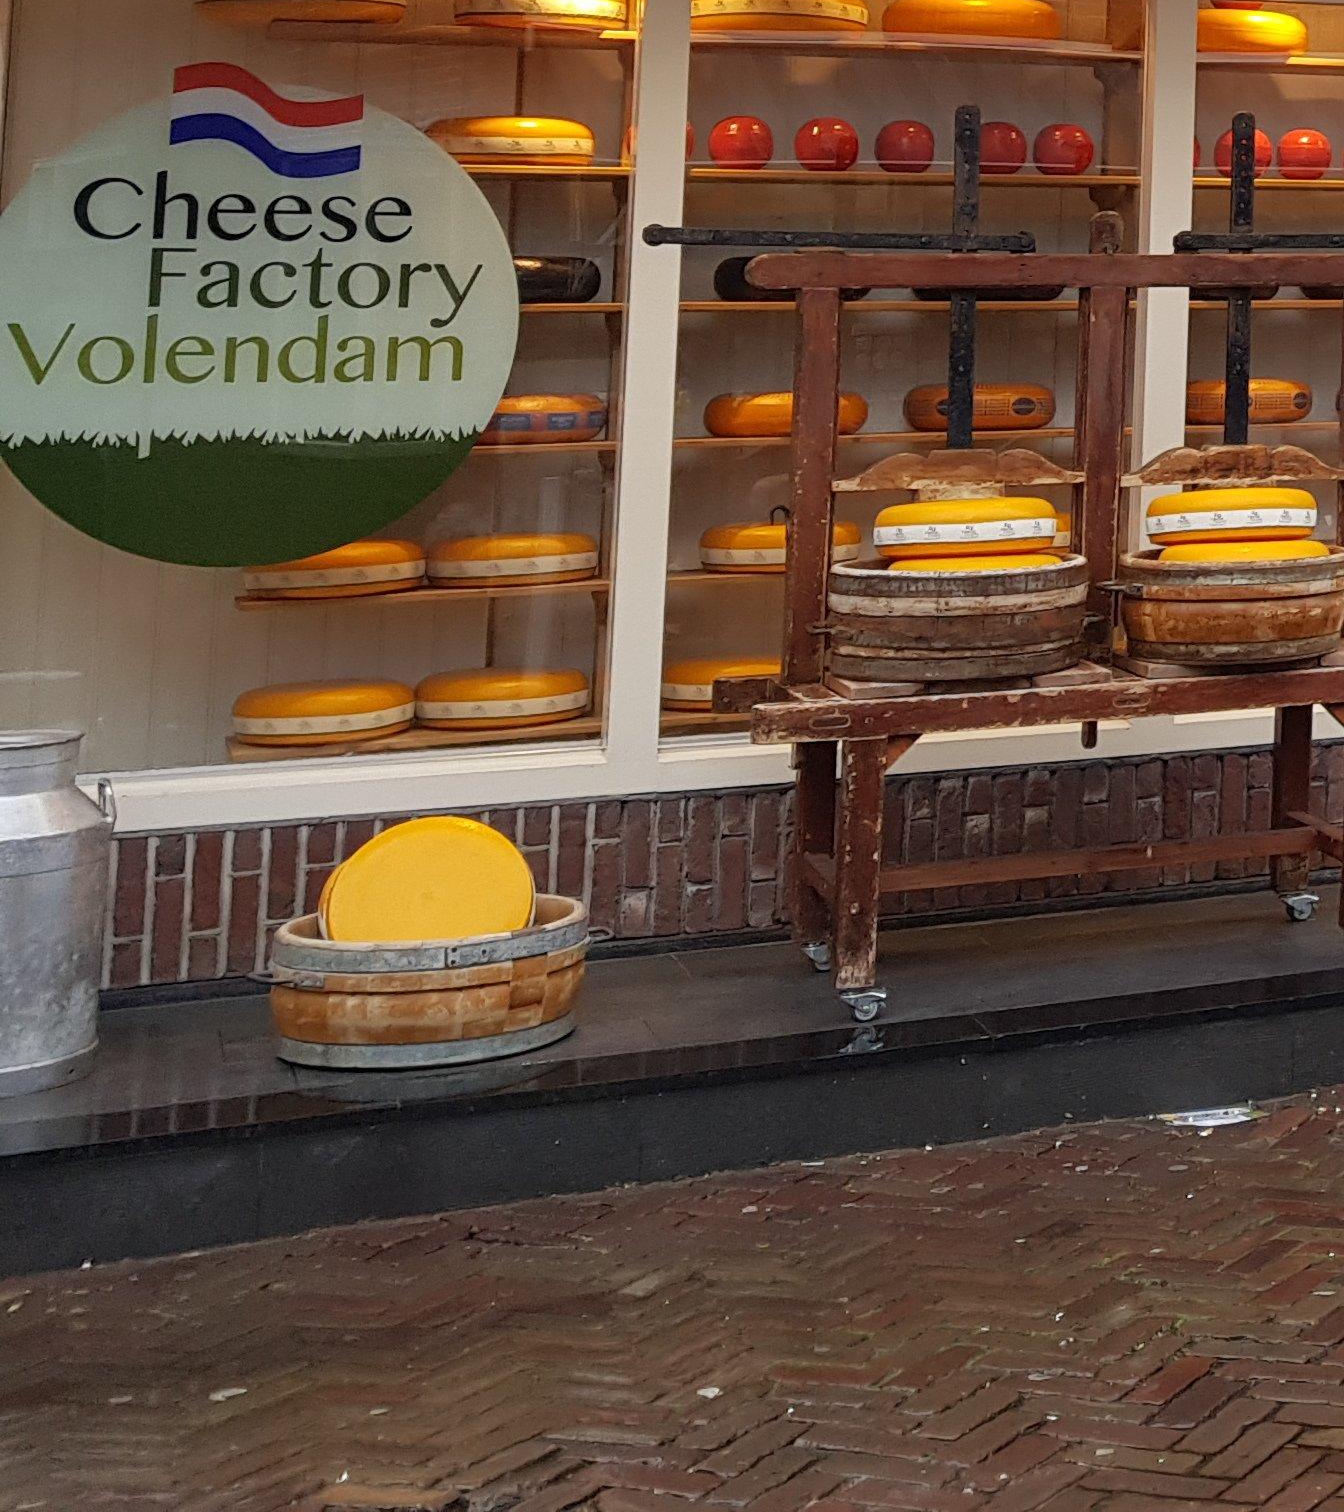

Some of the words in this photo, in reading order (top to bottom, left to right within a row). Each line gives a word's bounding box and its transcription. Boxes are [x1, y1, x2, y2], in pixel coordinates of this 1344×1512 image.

[74, 170, 413, 243] Cheese
[146, 247, 484, 328] Factory
[5, 313, 465, 385] Volendam
